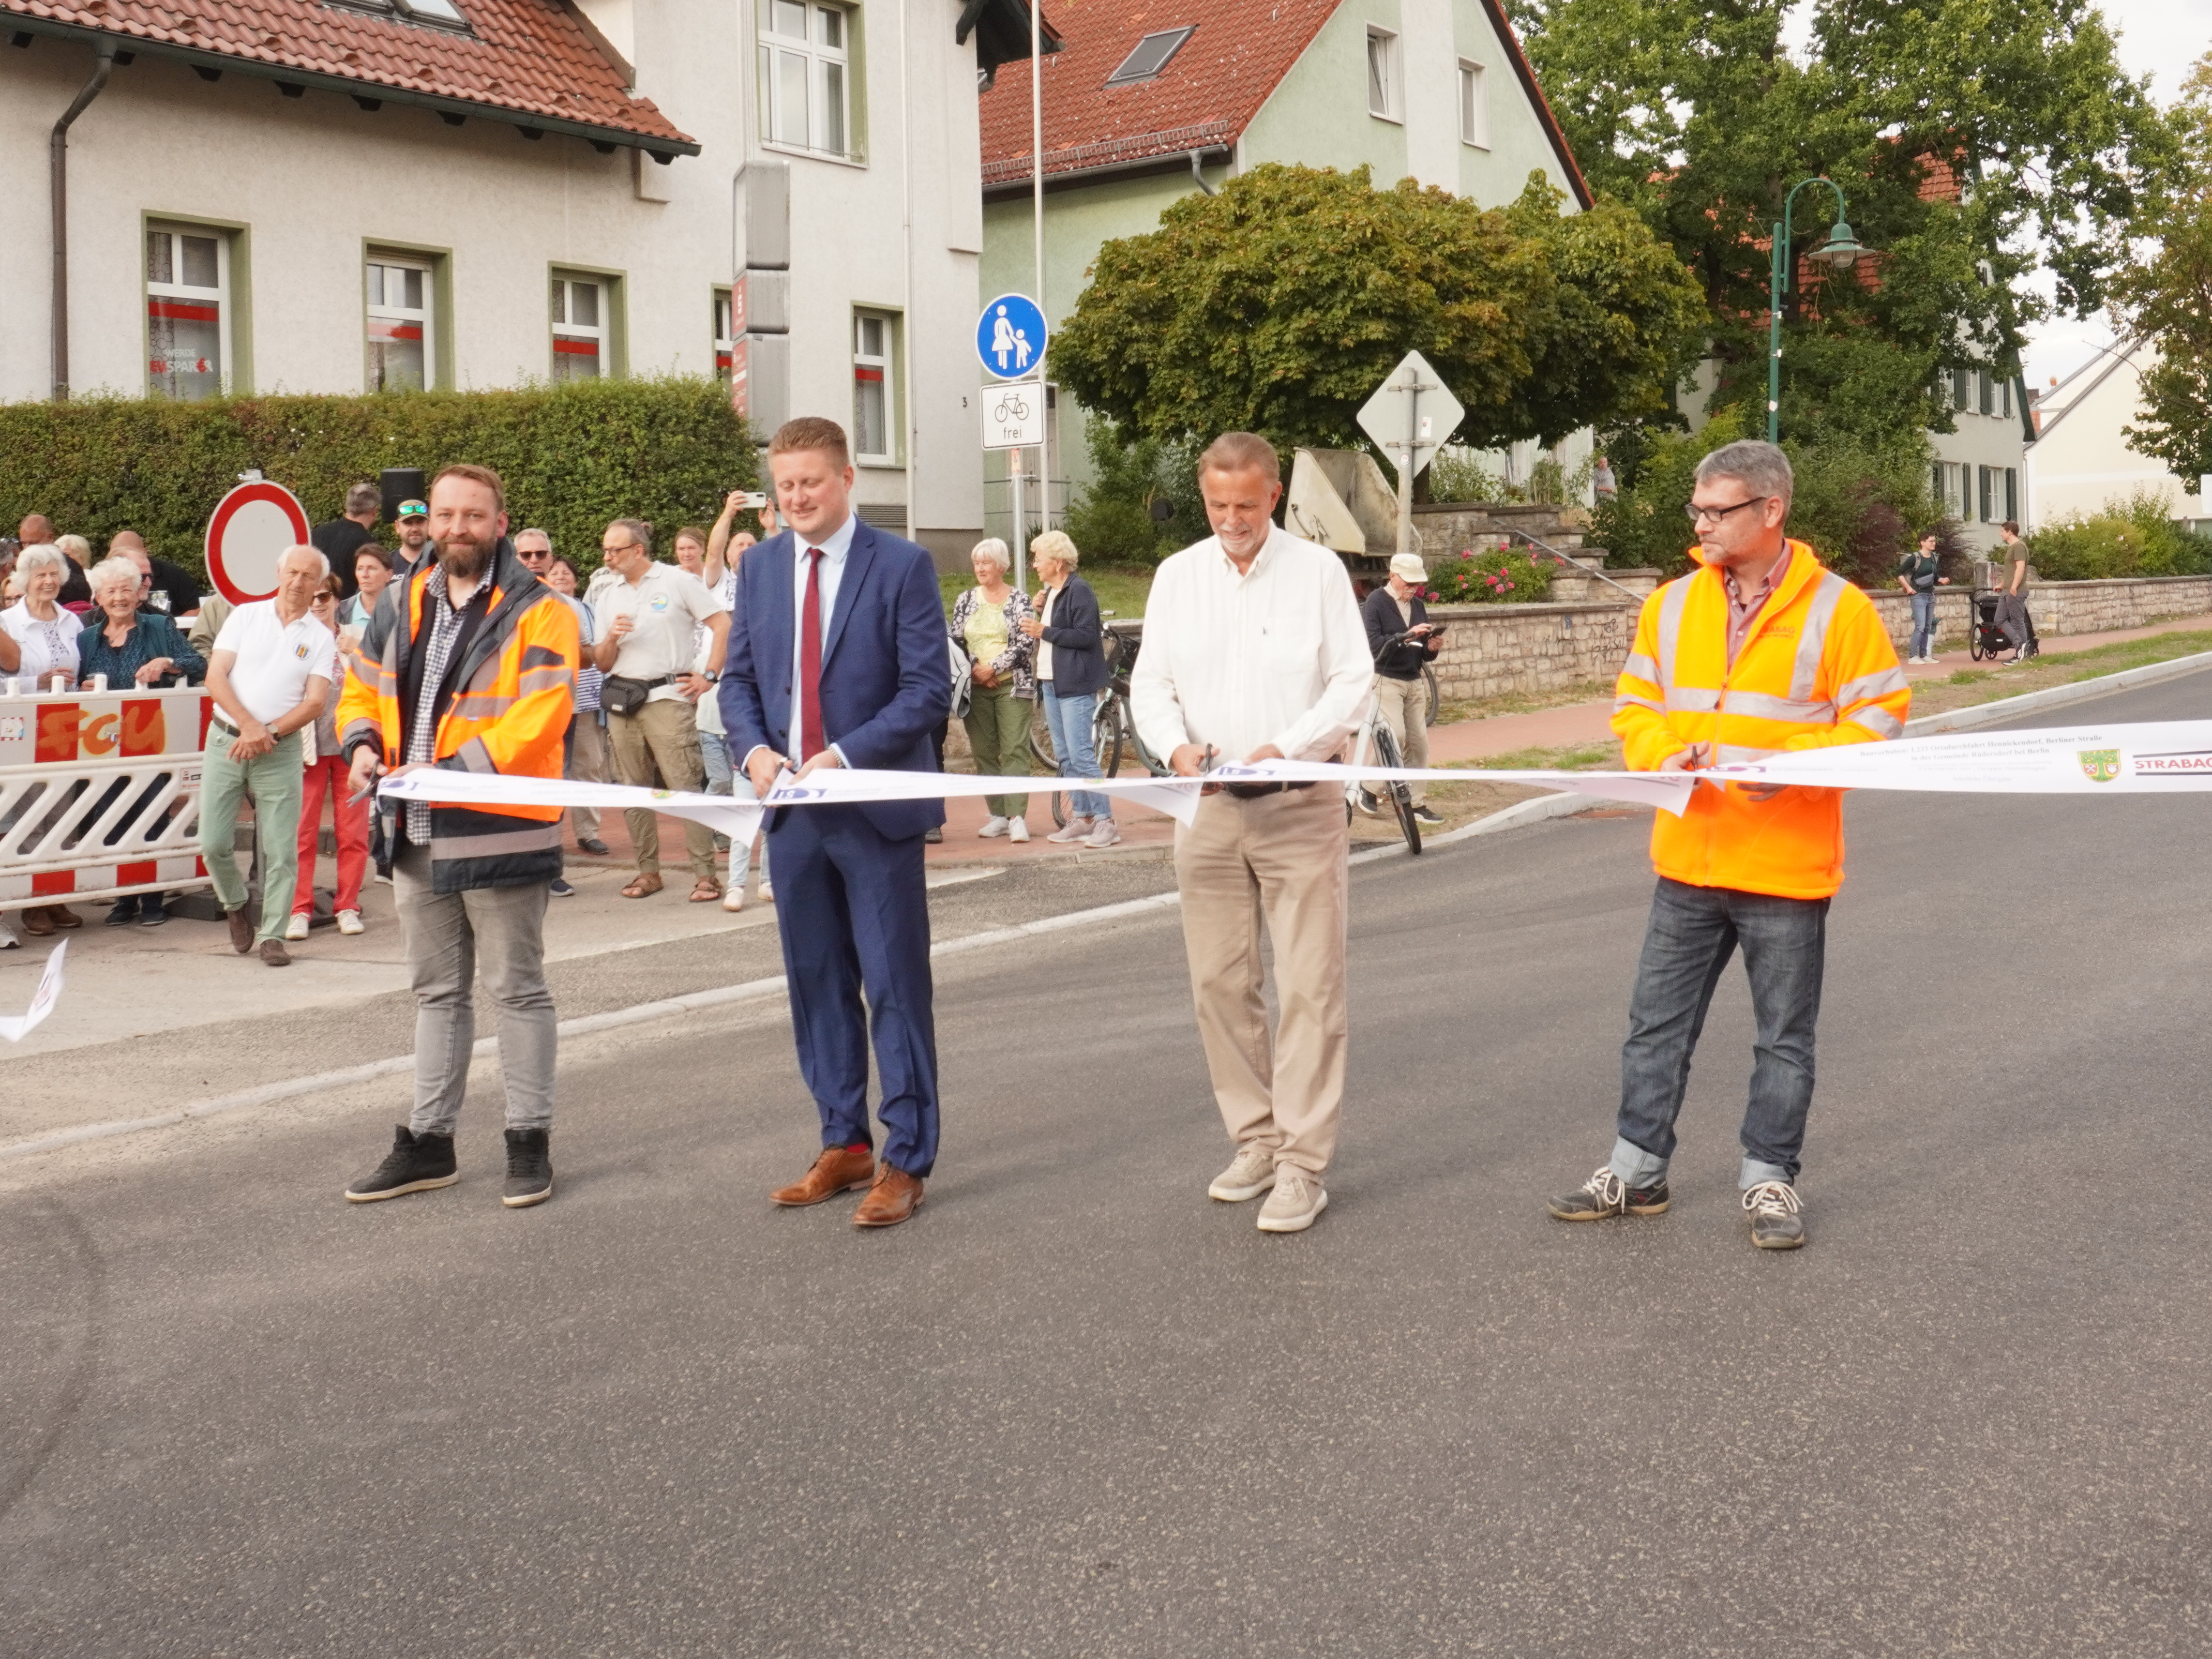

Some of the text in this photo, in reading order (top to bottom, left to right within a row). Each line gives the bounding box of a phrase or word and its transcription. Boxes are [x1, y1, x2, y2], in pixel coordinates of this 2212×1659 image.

[165, 349, 195, 357] WERDE
[962, 397, 968, 408] 3
[1003, 425, 1021, 439] frei
[1860, 748, 1909, 756] Bauvorhaben:
[1931, 742, 1985, 750] Ortsdurchfahrt
[1988, 738, 2044, 747] Hennickendorf,
[1972, 749, 2012, 757] Rüdersdorf
[777, 789, 795, 799] LS
